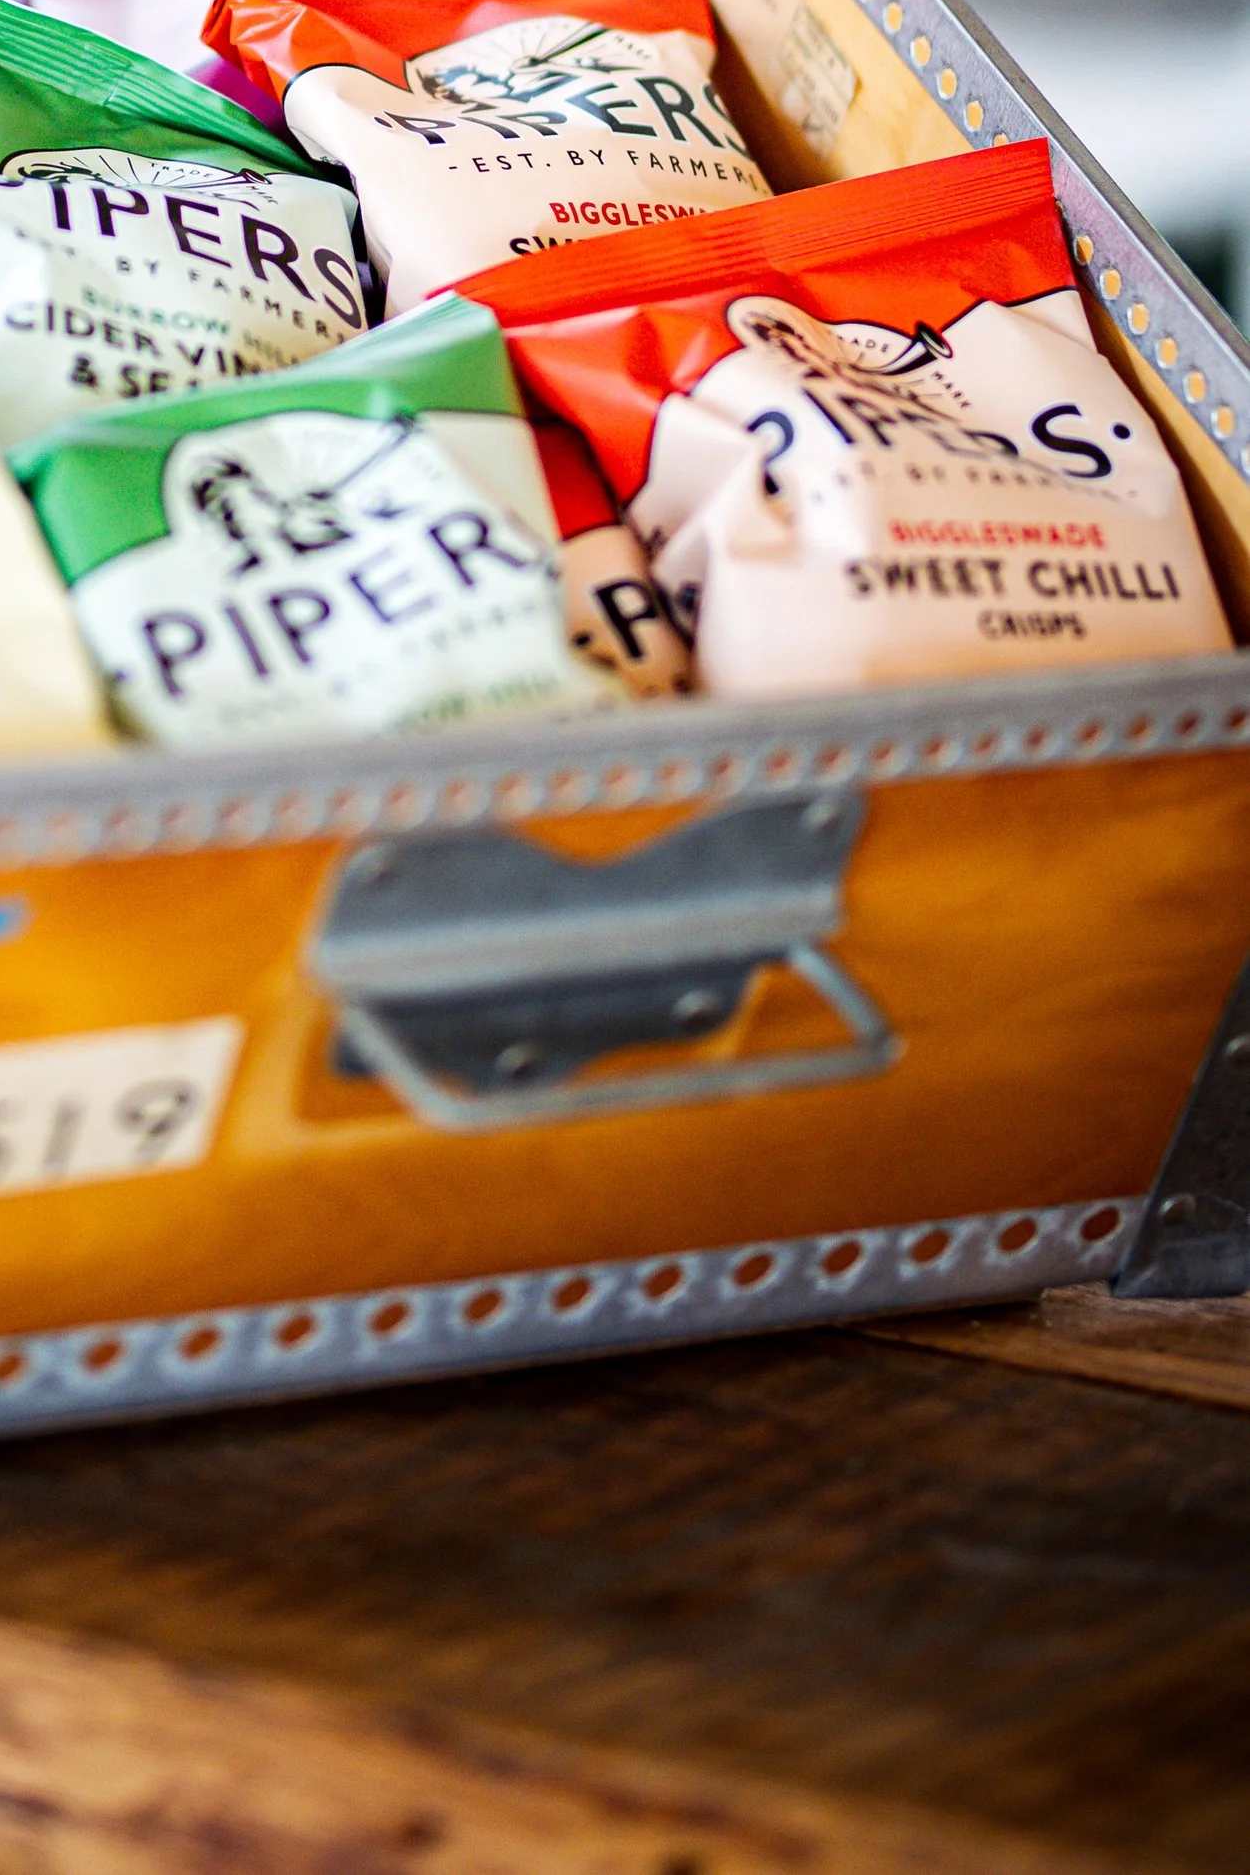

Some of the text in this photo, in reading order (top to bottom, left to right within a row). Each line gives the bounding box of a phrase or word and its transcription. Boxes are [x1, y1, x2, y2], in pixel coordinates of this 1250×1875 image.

[472, 152, 551, 174] EST.
[567, 148, 606, 167] BY
[4, 299, 161, 359] CIDER
[69, 351, 206, 401] & SE
[141, 509, 562, 700] PIPER
[846, 559, 1181, 601] SWEET CHILLI
